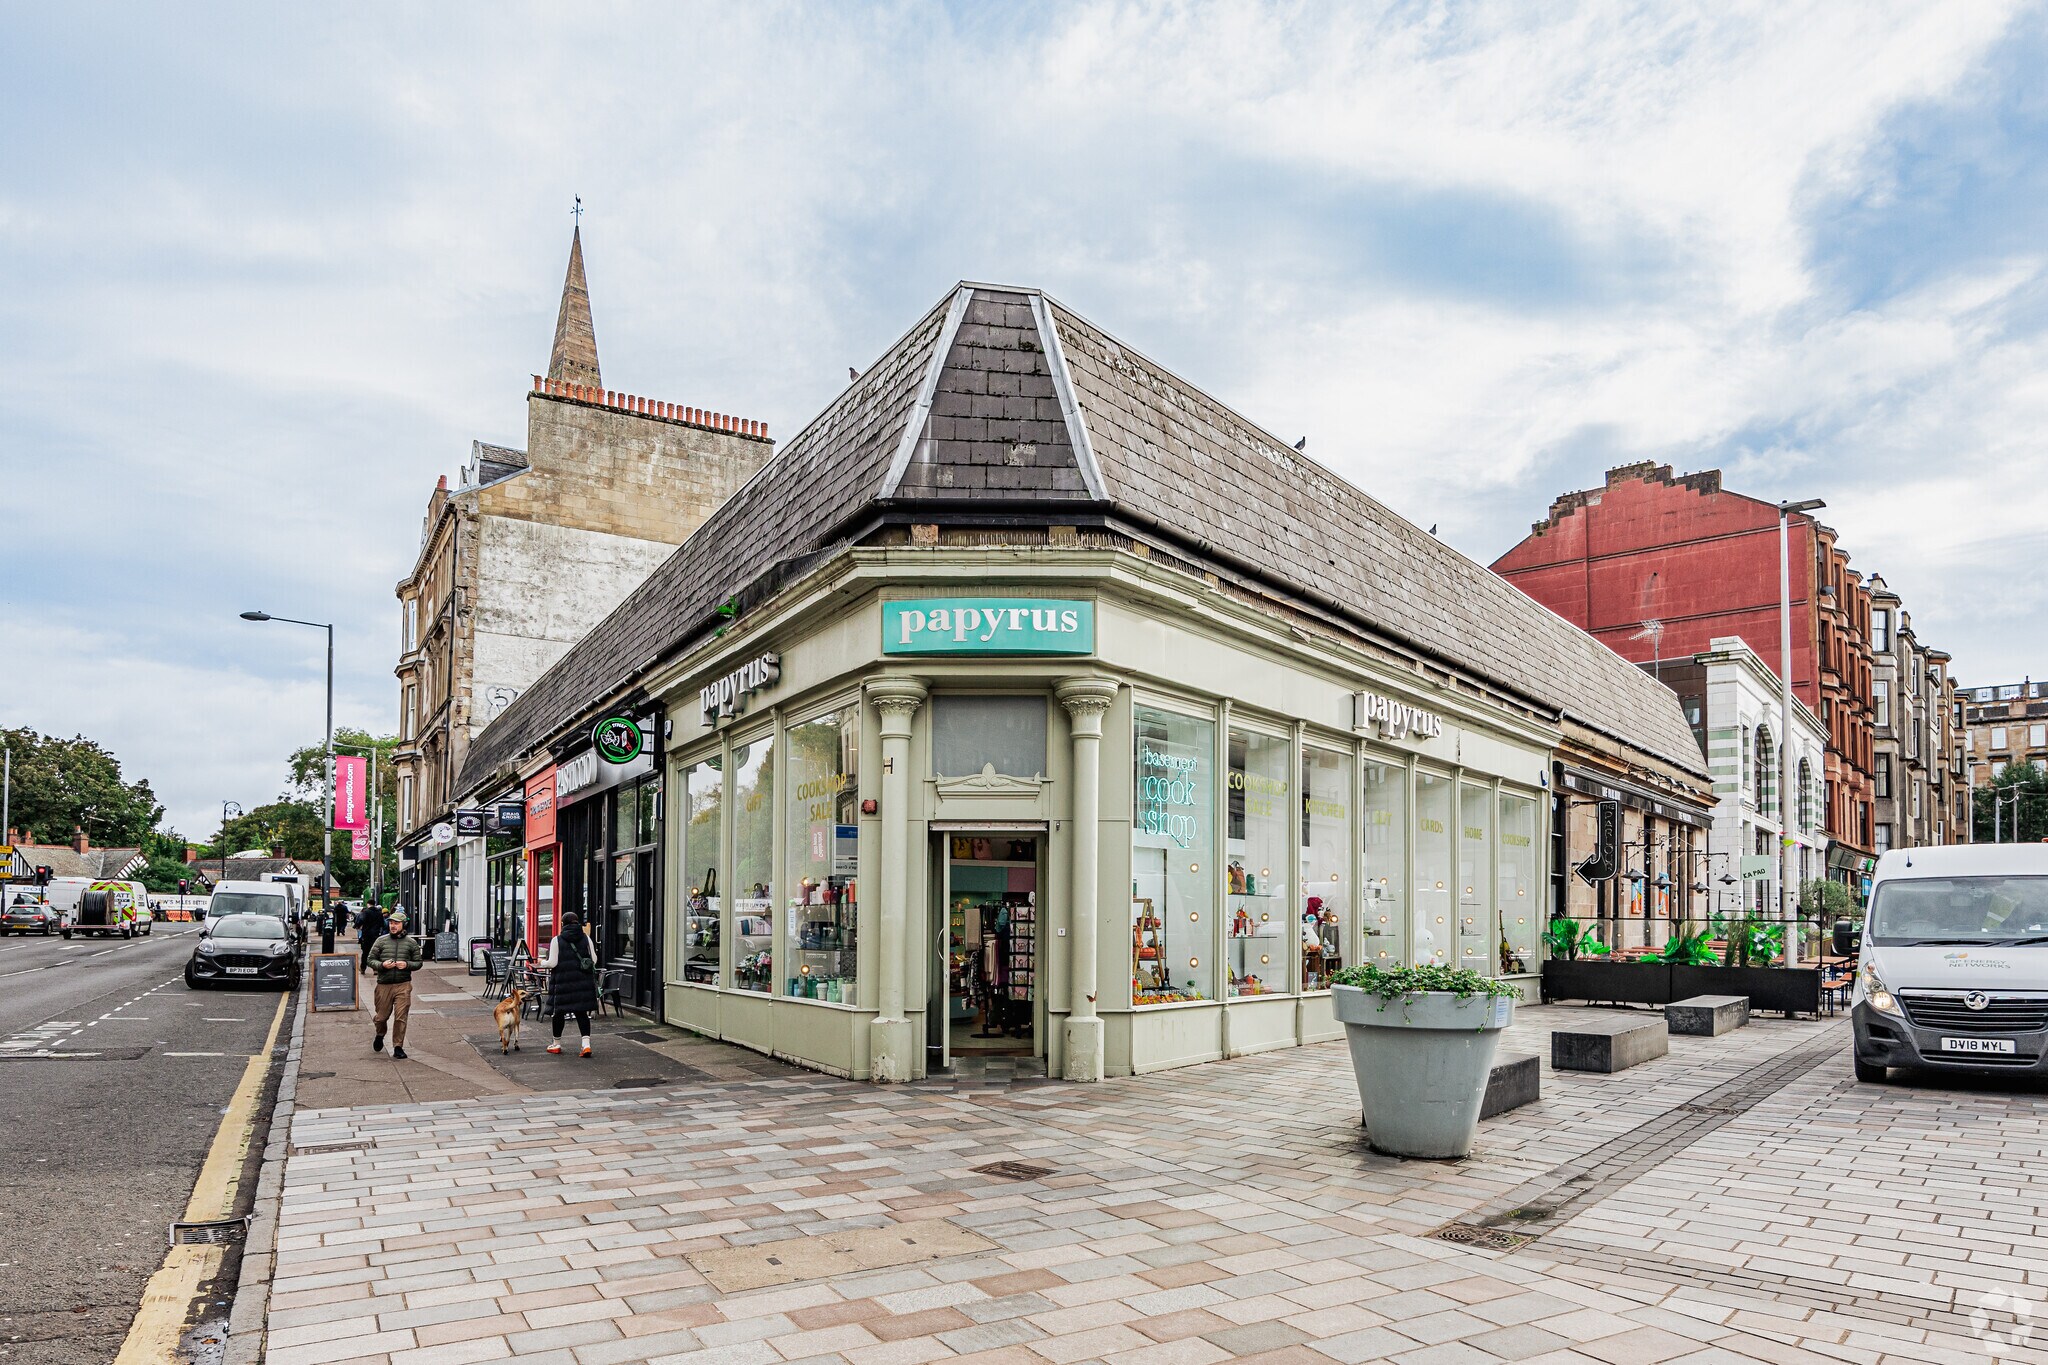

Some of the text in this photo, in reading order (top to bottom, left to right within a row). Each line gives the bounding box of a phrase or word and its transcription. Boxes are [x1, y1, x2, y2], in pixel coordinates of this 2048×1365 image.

[899, 608, 1078, 644] papyrus
[699, 653, 770, 726] papyrus
[1362, 690, 1442, 740] papyrus
[1143, 744, 1198, 772] basement
[346, 763, 354, 824] glasgow850.com
[797, 773, 847, 801] COOKSHOP
[1145, 770, 1197, 806] cook
[1228, 771, 1288, 798] COOKSHOP
[746, 793, 763, 813] GIFT
[810, 801, 832, 822] SALE
[1246, 797, 1272, 817] SALE
[1305, 798, 1345, 819] KITCHEN
[1146, 800, 1197, 848] shop
[1421, 818, 1444, 834] CARDS
[1464, 826, 1483, 840] HOME
[1502, 833, 1530, 848] COOKSHOP
[1604, 811, 1613, 872] PARLOUR
[1950, 1040, 2007, 1052] DV18 MYL
